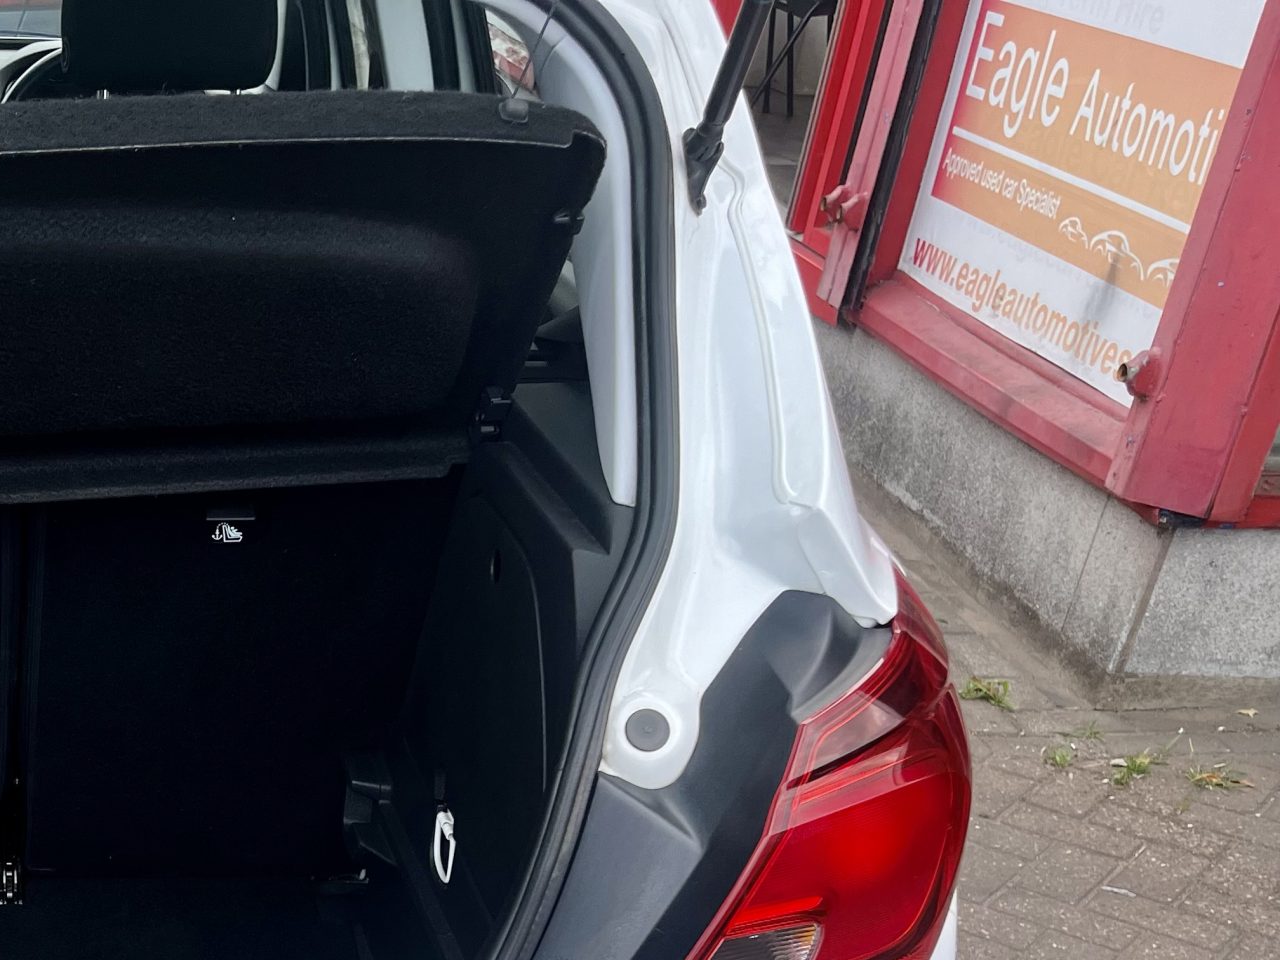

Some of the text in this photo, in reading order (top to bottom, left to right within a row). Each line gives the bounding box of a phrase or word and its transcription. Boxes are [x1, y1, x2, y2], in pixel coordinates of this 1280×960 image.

[966, 10, 1225, 185] Eagle Automoti
[942, 147, 1061, 219] Approved used car Specialist
